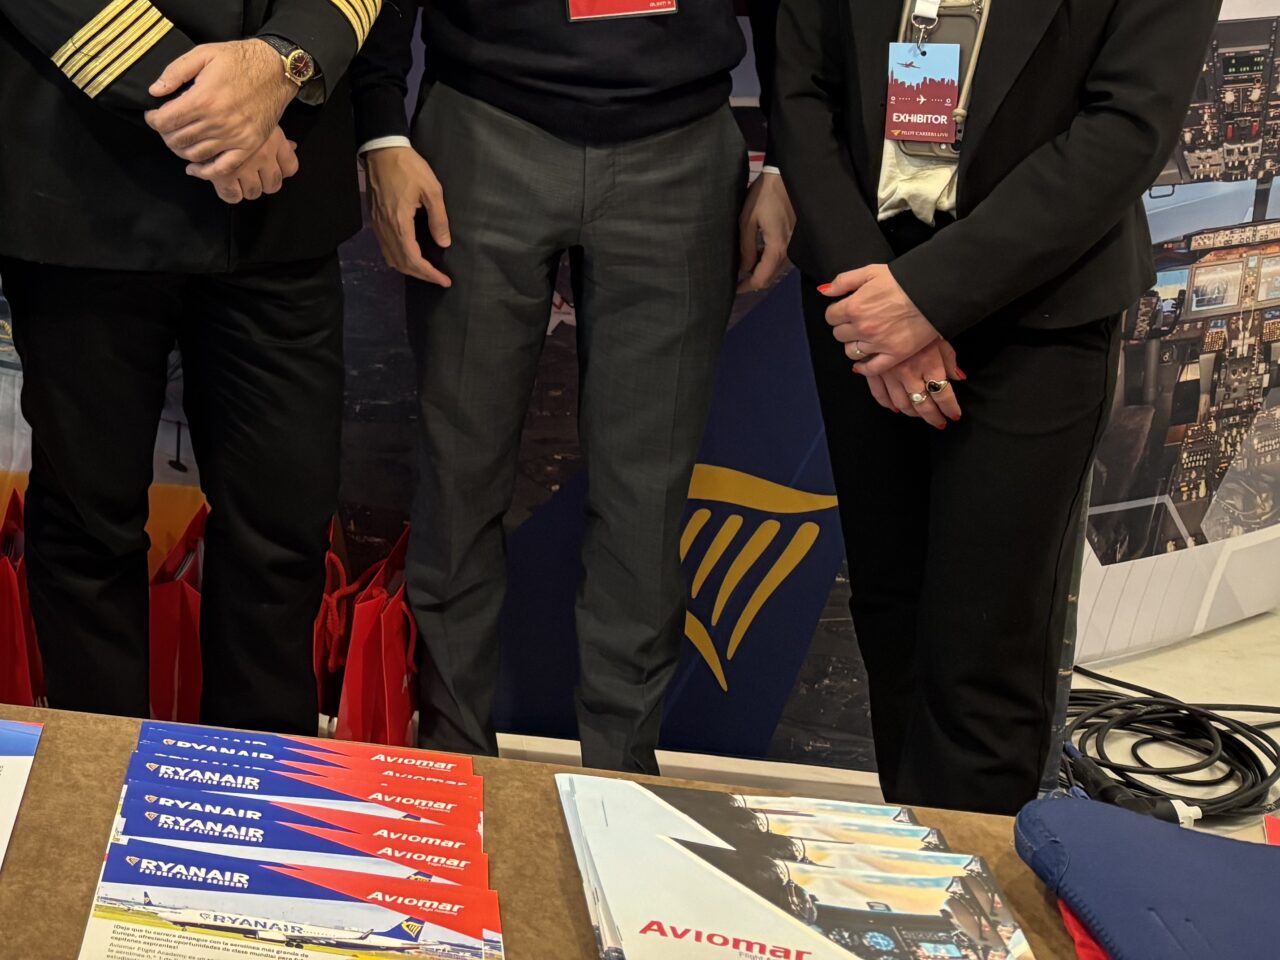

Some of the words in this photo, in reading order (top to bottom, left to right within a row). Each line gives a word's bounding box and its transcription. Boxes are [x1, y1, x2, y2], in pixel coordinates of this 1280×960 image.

[892, 112, 948, 125] EXHIBITOR
[371, 753, 457, 770] Aviomar
[158, 764, 260, 786] RYANAIR
[158, 797, 263, 820] RYANAIR
[368, 792, 458, 810] Aviomar
[158, 814, 265, 838] RYANAIR
[373, 828, 466, 849] Aviomar
[377, 847, 471, 868] Aviomar
[140, 859, 250, 884] RYANAIR
[367, 891, 465, 912] Aviomar
[212, 914, 305, 934] RYANAIR
[639, 920, 813, 960] Aviomar
